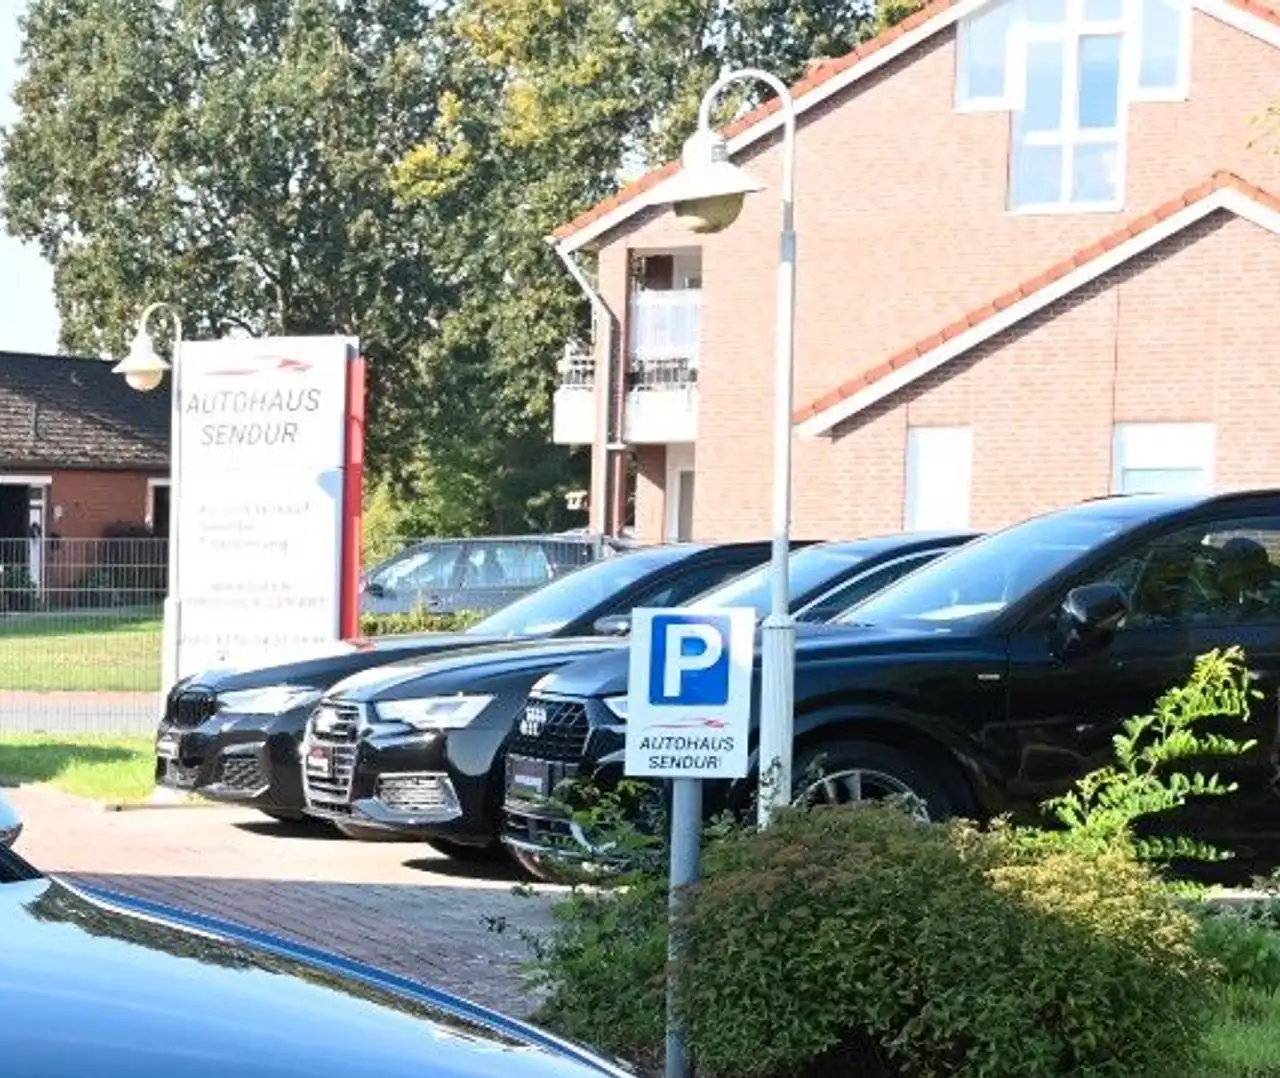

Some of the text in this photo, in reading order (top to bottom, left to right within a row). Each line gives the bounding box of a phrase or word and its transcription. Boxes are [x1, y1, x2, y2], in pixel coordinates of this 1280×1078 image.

[186, 388, 321, 415] AUTOHAUS
[201, 422, 299, 446] SENDUR
[663, 623, 722, 697] P
[640, 736, 734, 751] AUTOHAUS
[649, 755, 717, 769] SENDUR
